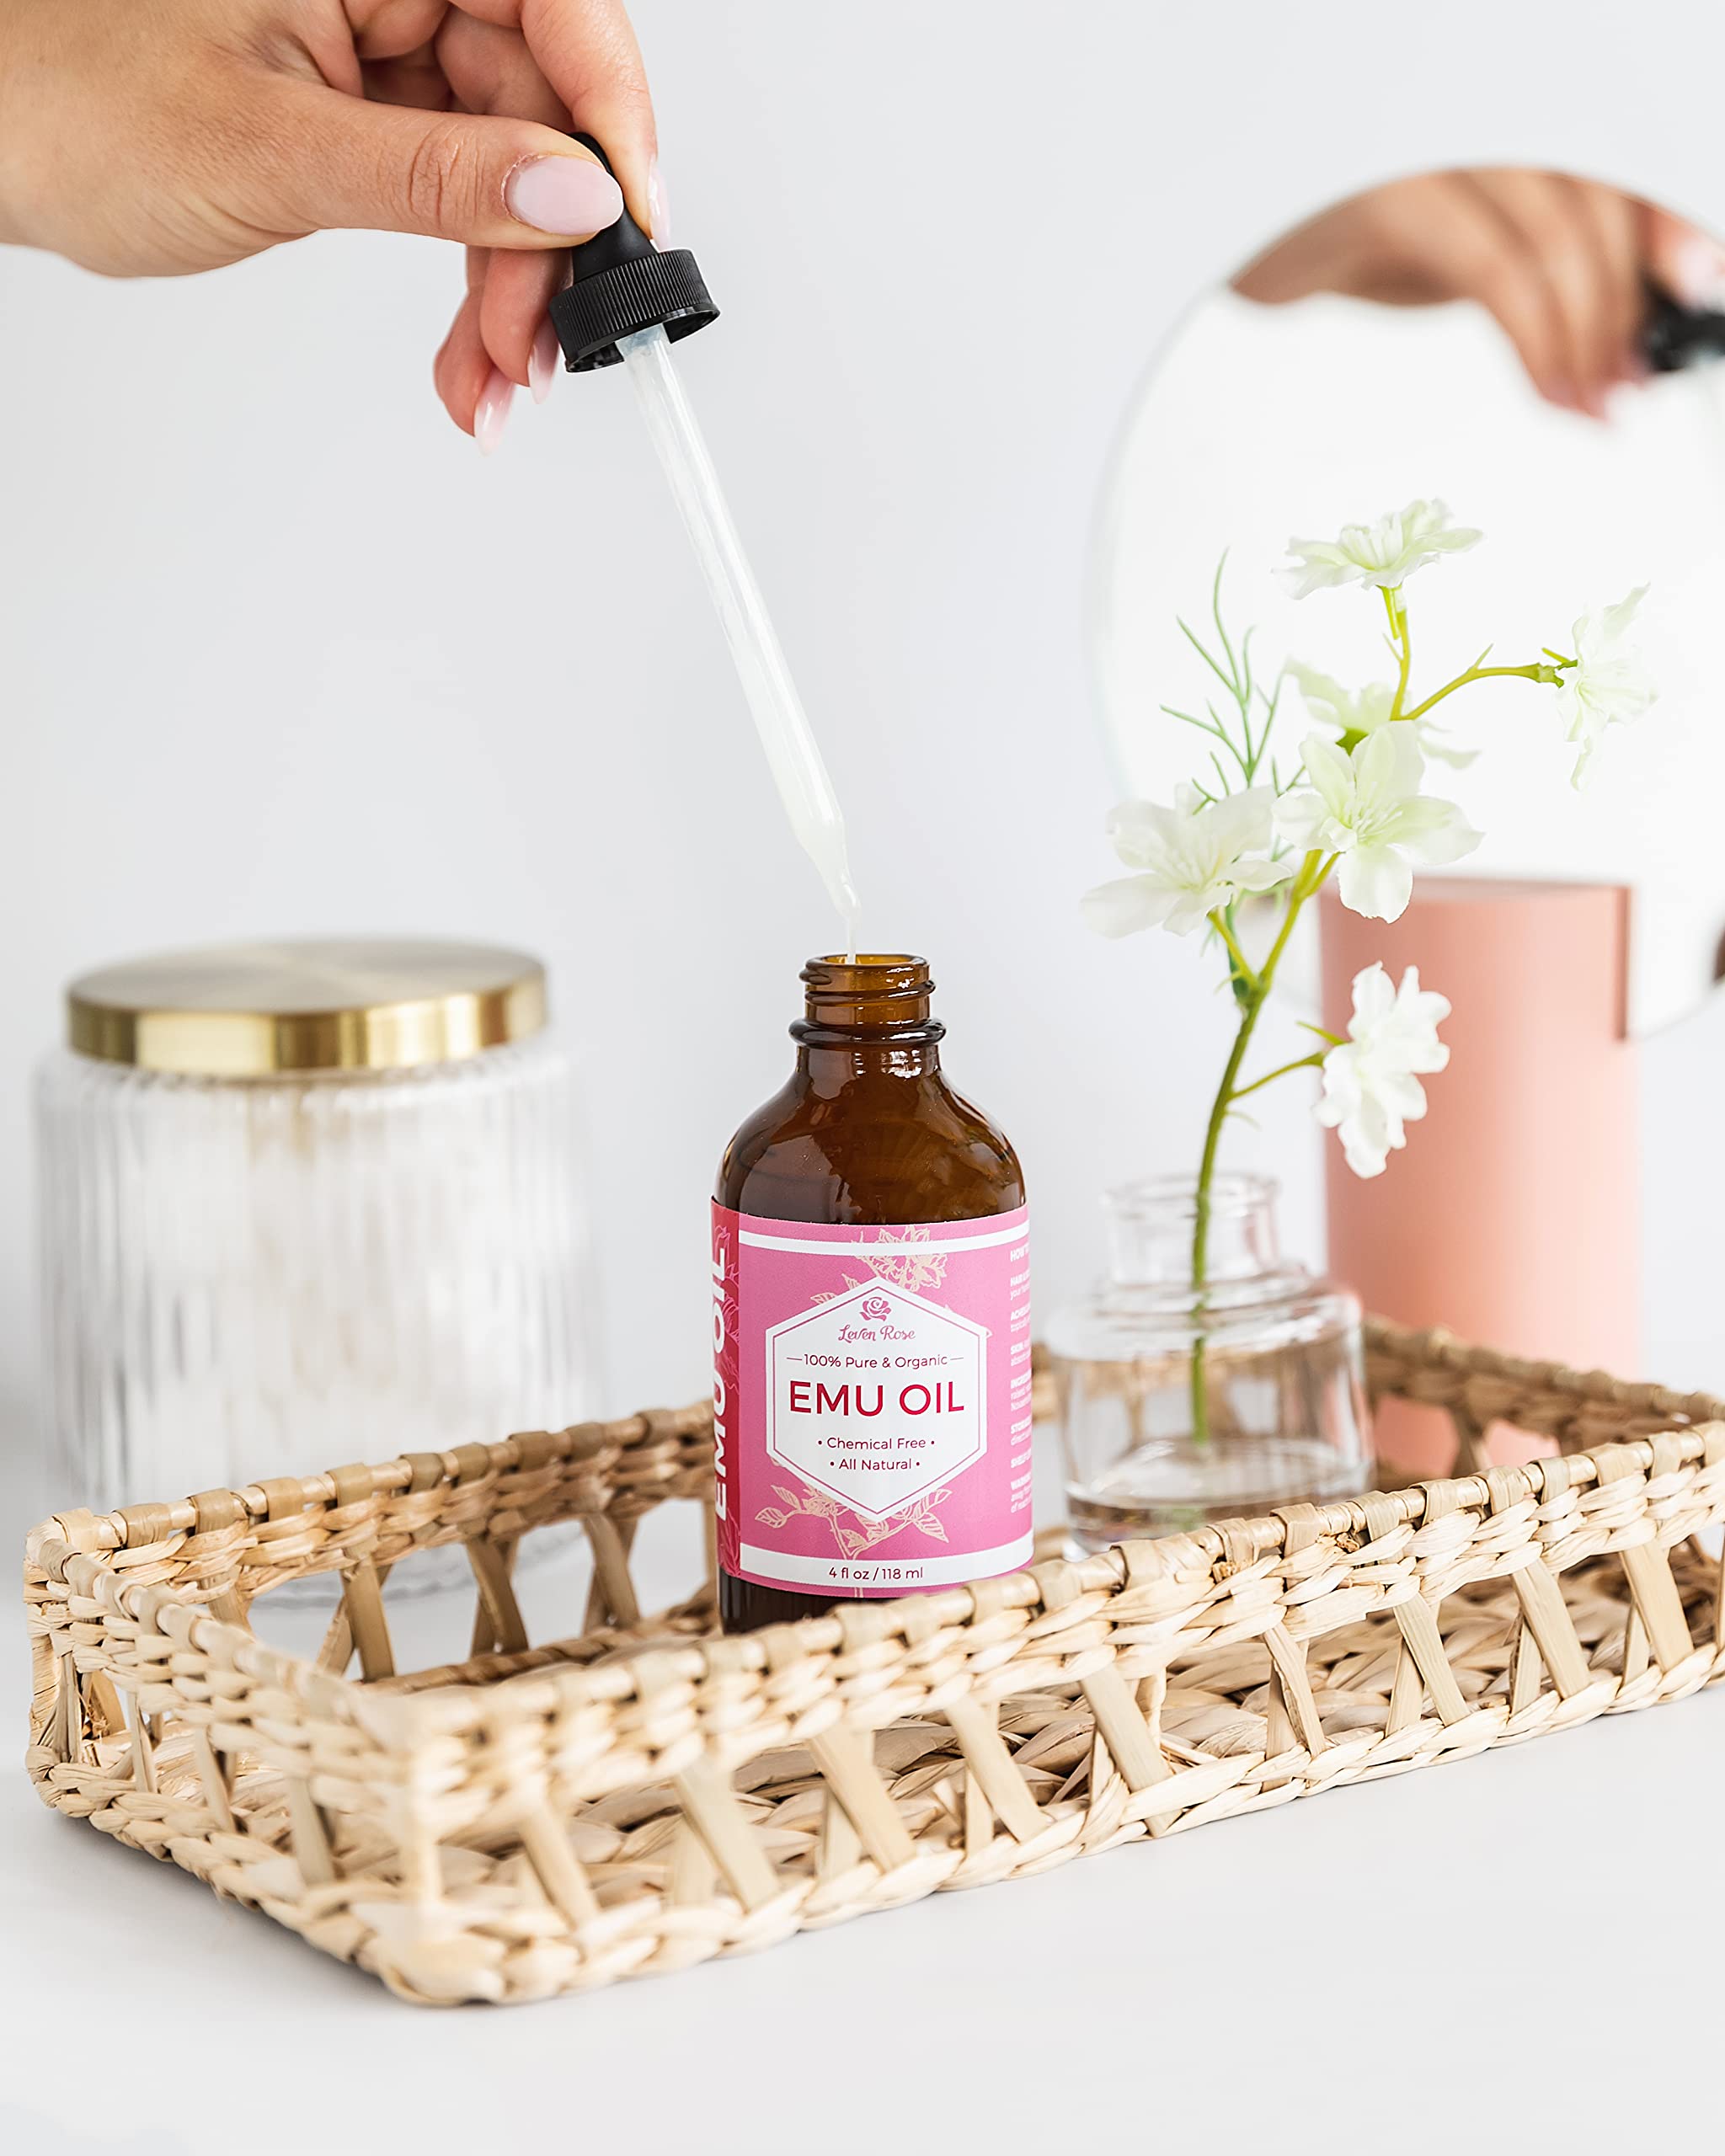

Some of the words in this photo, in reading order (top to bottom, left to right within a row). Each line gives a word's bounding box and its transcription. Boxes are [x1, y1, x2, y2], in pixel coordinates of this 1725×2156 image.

[712, 1247, 726, 1354] OIL
[838, 1325, 877, 1343] Leven
[880, 1326, 916, 1341] Rose
[804, 1354, 841, 1368] 100%
[846, 1357, 878, 1369] Pure
[882, 1358, 891, 1369] &
[895, 1354, 948, 1370] Organic
[790, 1380, 884, 1417] EMU
[899, 1381, 964, 1416] OIL
[713, 1369, 727, 1521] EMU
[826, 1437, 893, 1450] Chemical
[897, 1438, 927, 1449] Free
[838, 1458, 857, 1470] All
[861, 1458, 912, 1471] Natural
[829, 1566, 837, 1578] 4
[841, 1567, 849, 1579] fl
[853, 1571, 869, 1580] oz
[882, 1568, 901, 1580] 118
[905, 1566, 923, 1579] ml
